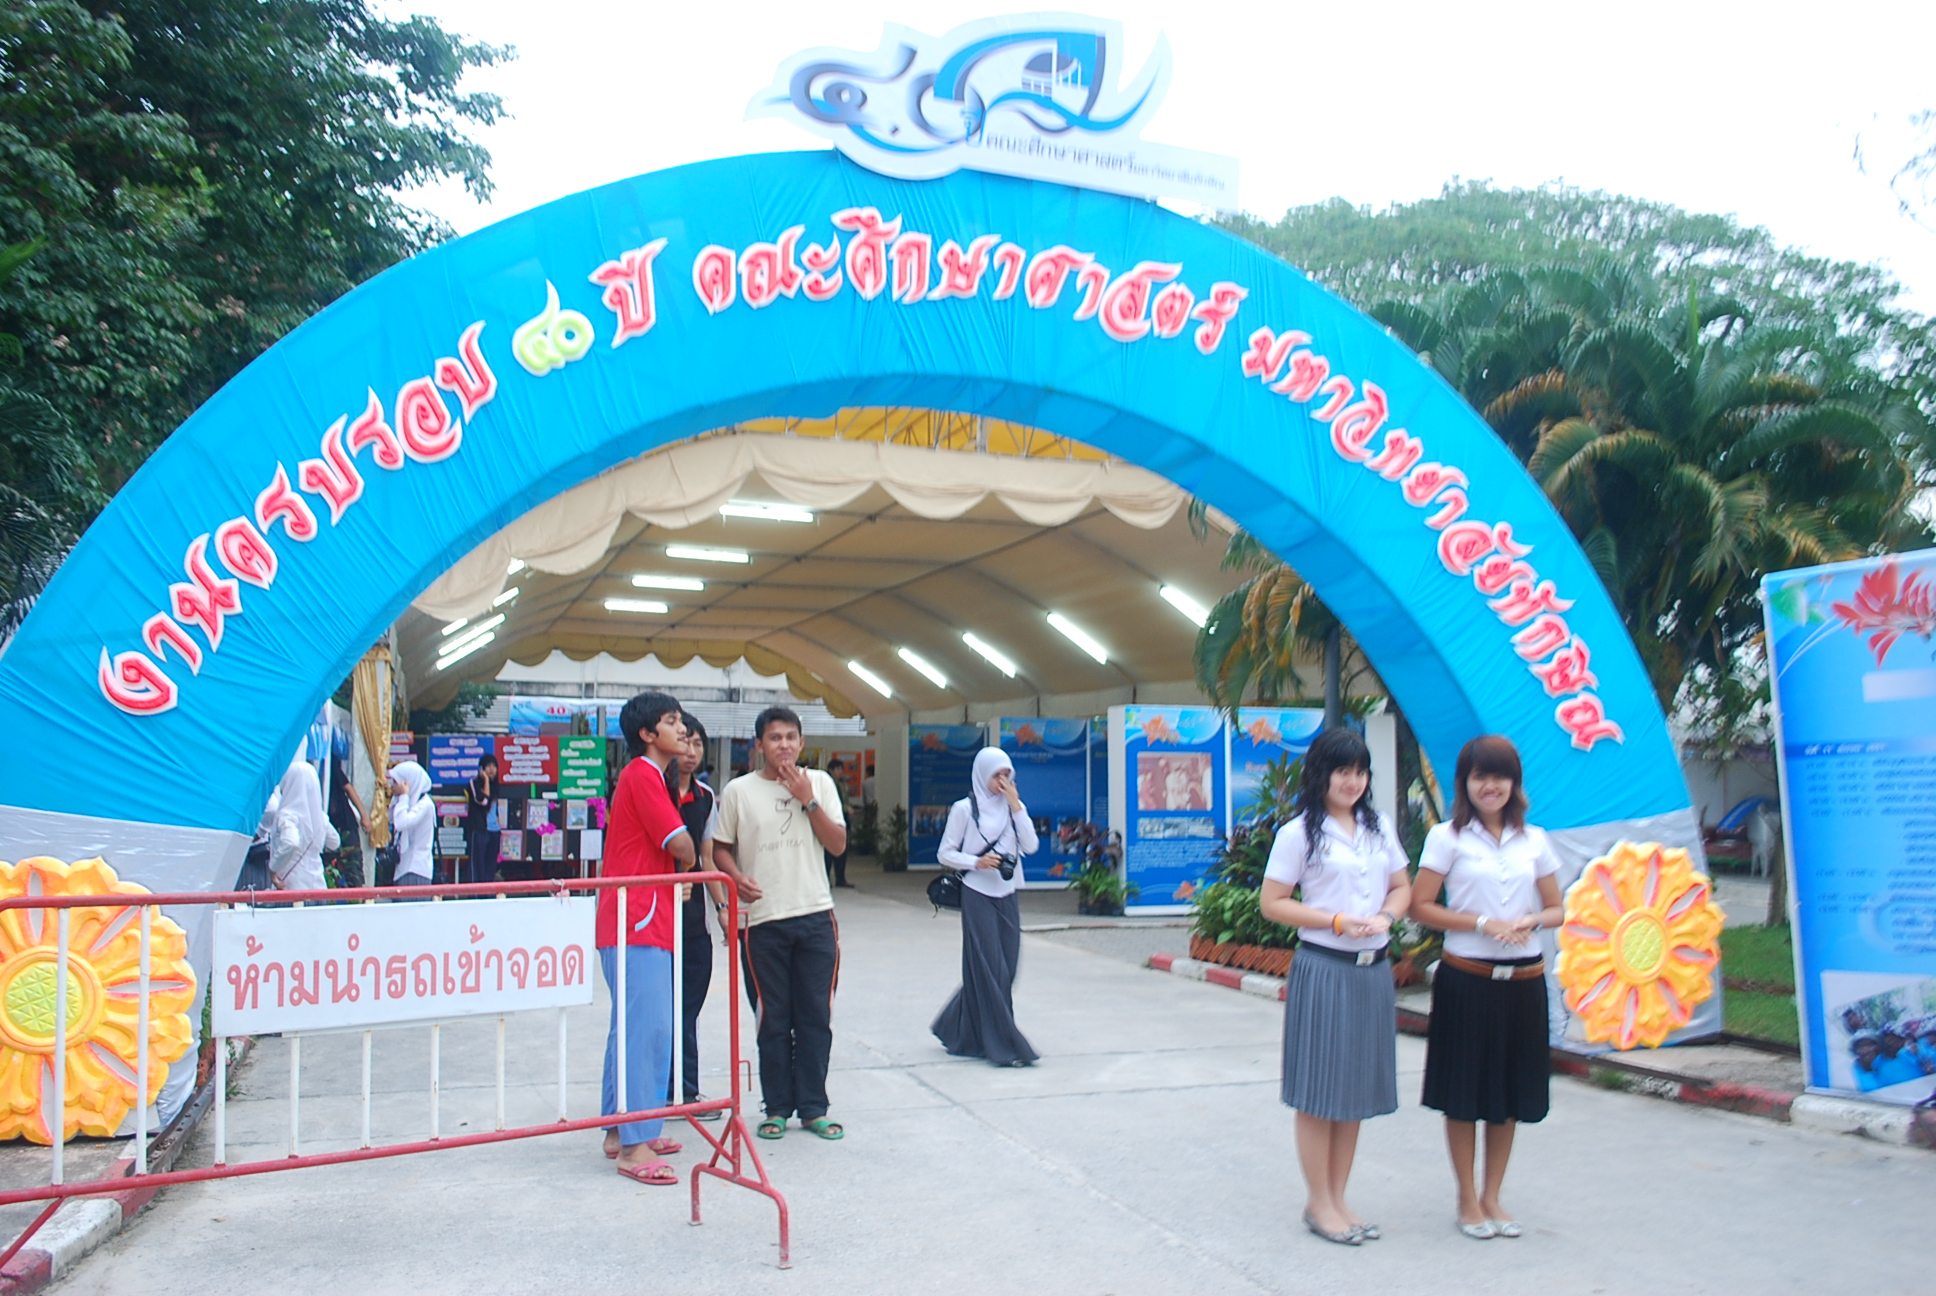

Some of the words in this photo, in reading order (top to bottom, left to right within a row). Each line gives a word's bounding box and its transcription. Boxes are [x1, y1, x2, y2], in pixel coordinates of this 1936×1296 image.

[512, 279, 594, 376] ๔๐
[589, 237, 668, 348] ปี
[692, 206, 1248, 355] คณะศึกษาศาสตร์
[1241, 326, 1626, 752] มหาวิทยาลัยทักษิณ
[227, 924, 585, 1011] ห้ามนำรถเข้าจอด
